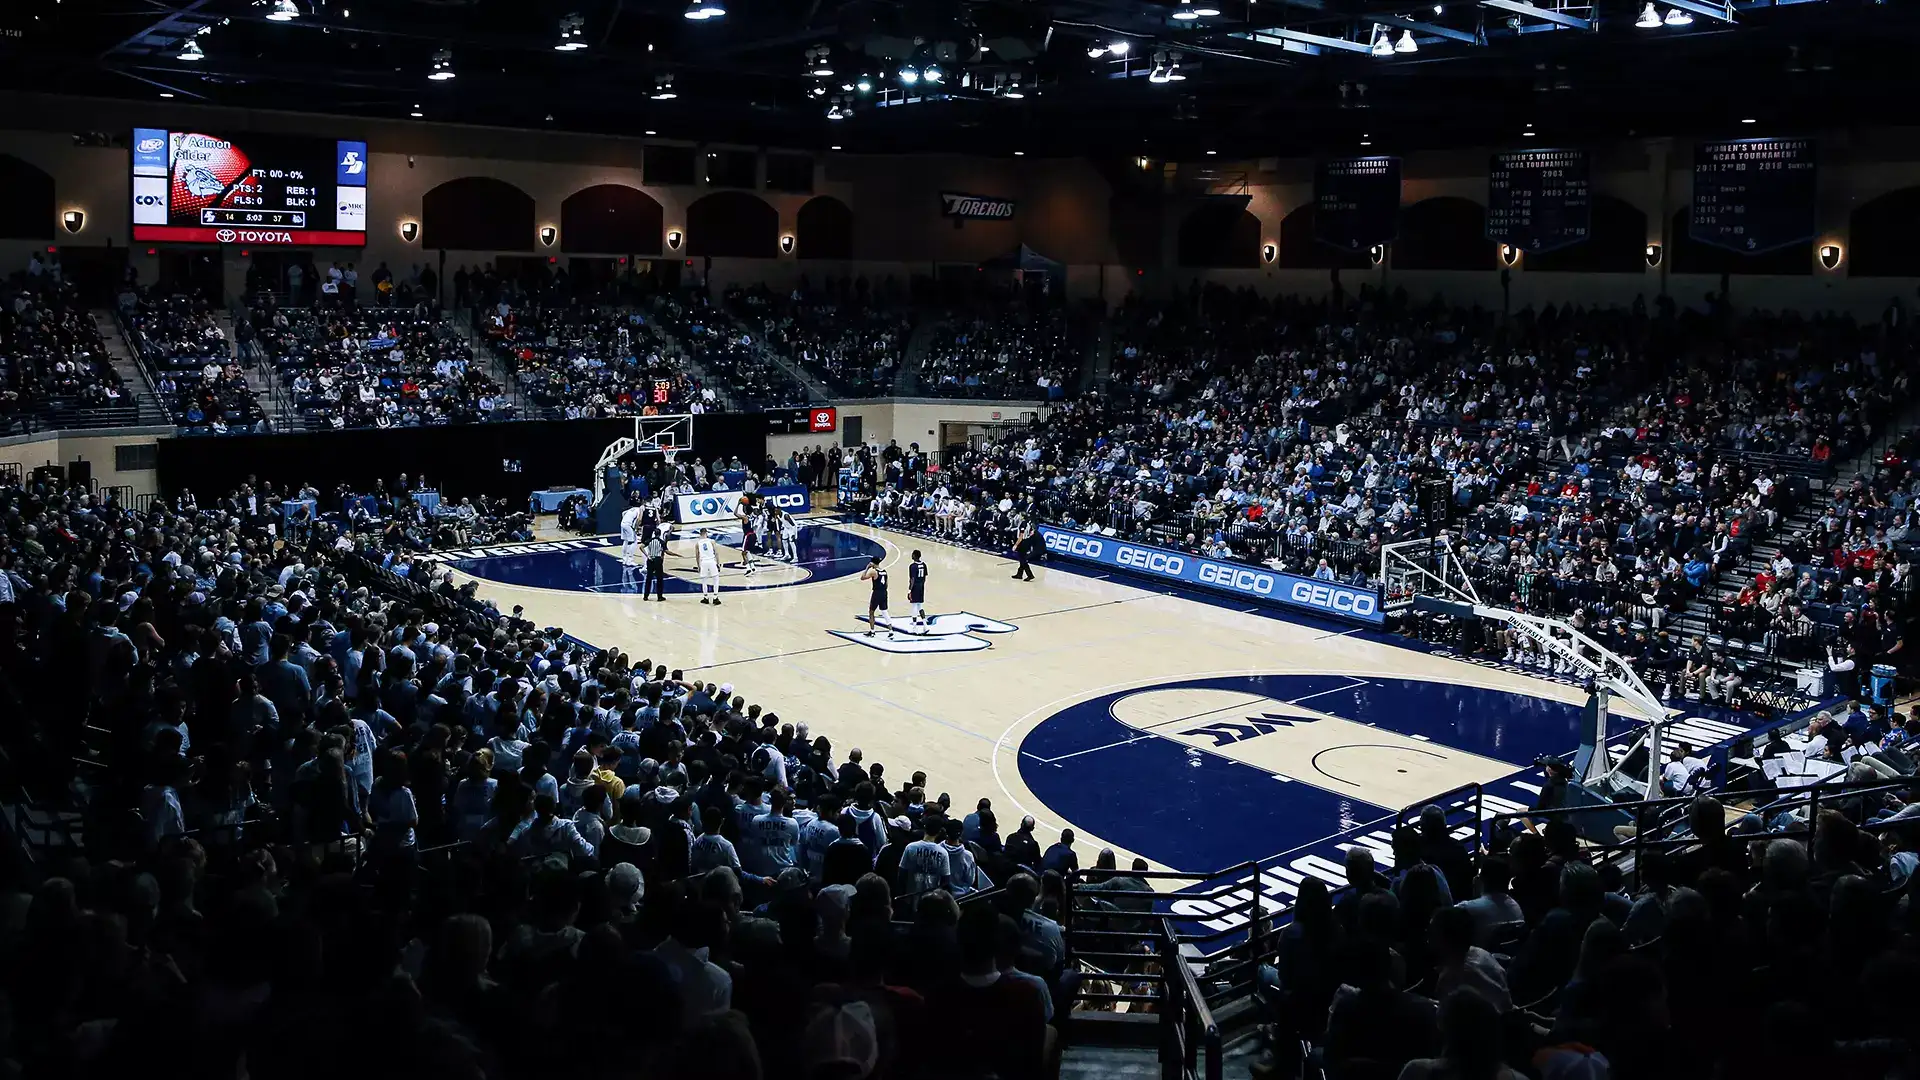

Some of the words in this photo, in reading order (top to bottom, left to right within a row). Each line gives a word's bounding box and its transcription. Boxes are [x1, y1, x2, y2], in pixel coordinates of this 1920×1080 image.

[188, 136, 231, 149] Admon
[174, 150, 210, 161] Gilder
[252, 169, 266, 178] FT:
[270, 169, 283, 179] 0/0
[290, 170, 304, 179] 0%
[233, 184, 254, 193] PTS:
[257, 184, 262, 193] 2
[287, 186, 308, 195] REB:
[311, 187, 316, 196] 1
[135, 195, 163, 206] COX
[234, 196, 254, 205] FLS:
[257, 196, 262, 205] 0
[287, 198, 308, 207] BLK:
[310, 198, 316, 207] 0
[942, 194, 1015, 217] TOREROS
[226, 213, 234, 221] 14
[246, 214, 262, 222] 5:03
[273, 215, 282, 223] 37
[238, 231, 292, 243] TOYOTA
[653, 389, 667, 403] 30
[690, 497, 733, 516] COX
[1045, 531, 1103, 558] GEICO
[1116, 546, 1184, 576] GEICO
[1198, 563, 1274, 594] GEICO
[1291, 582, 1375, 617] GEICO
[1507, 615, 1548, 645] UNIVERSITY
[1558, 648, 1575, 662] SAN
[1575, 658, 1594, 674] DIEGO
[758, 820, 786, 832] HOME
[916, 847, 942, 860] HOME
